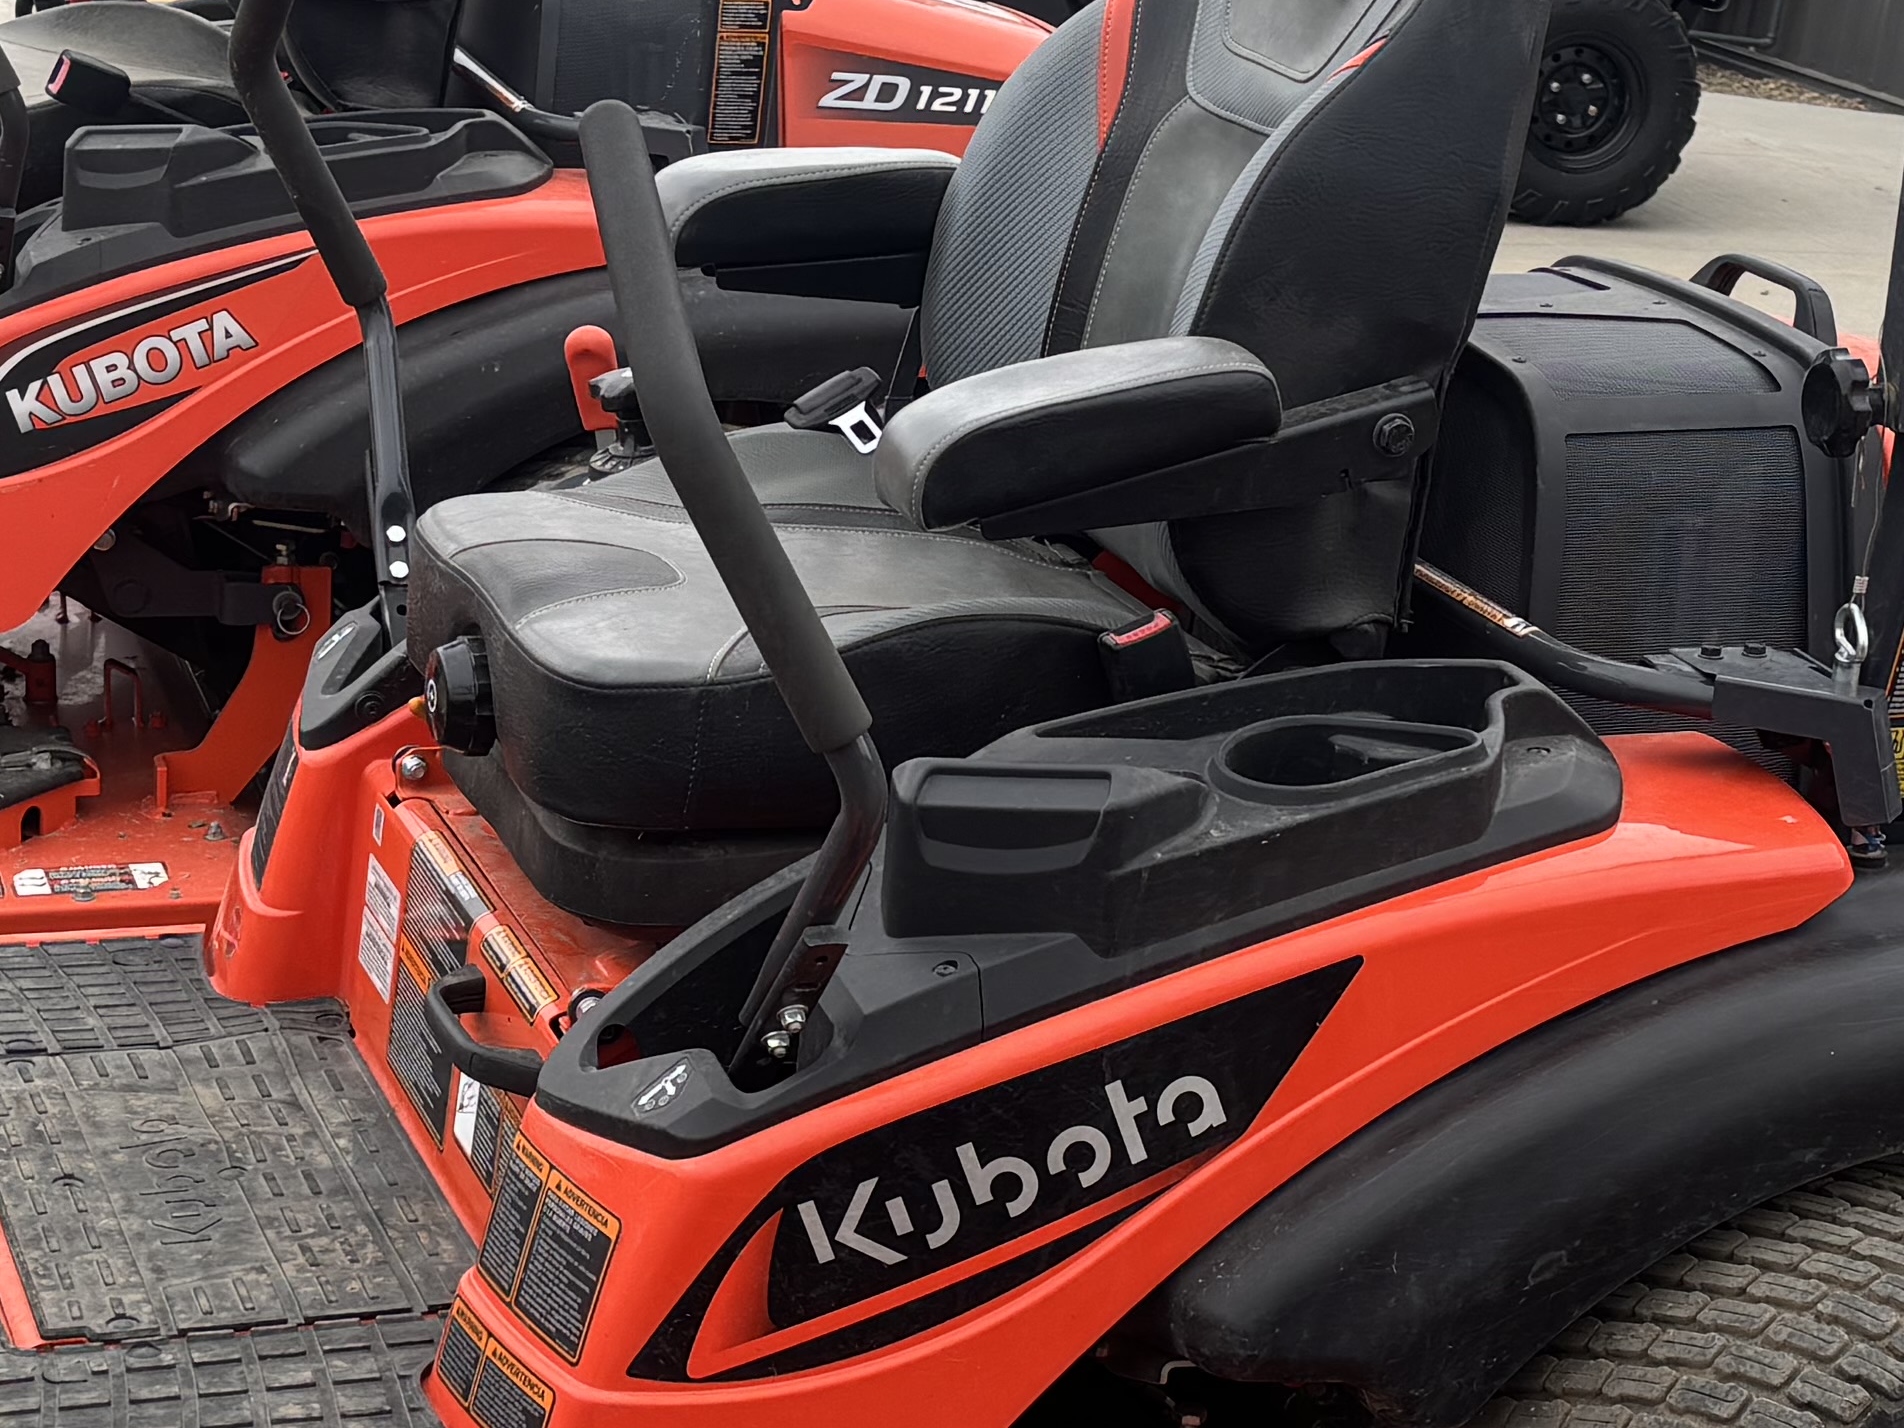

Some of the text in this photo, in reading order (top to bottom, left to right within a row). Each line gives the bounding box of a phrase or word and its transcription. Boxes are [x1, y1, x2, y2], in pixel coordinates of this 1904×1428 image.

[817, 71, 911, 111] ZD
[5, 310, 258, 433] KUBOTA
[119, 1118, 224, 1245] Kubota
[564, 1186, 608, 1229] ADVERTENCIA
[798, 1075, 1227, 1266] Kubota
[497, 1351, 545, 1402] ADVERTENCIA
